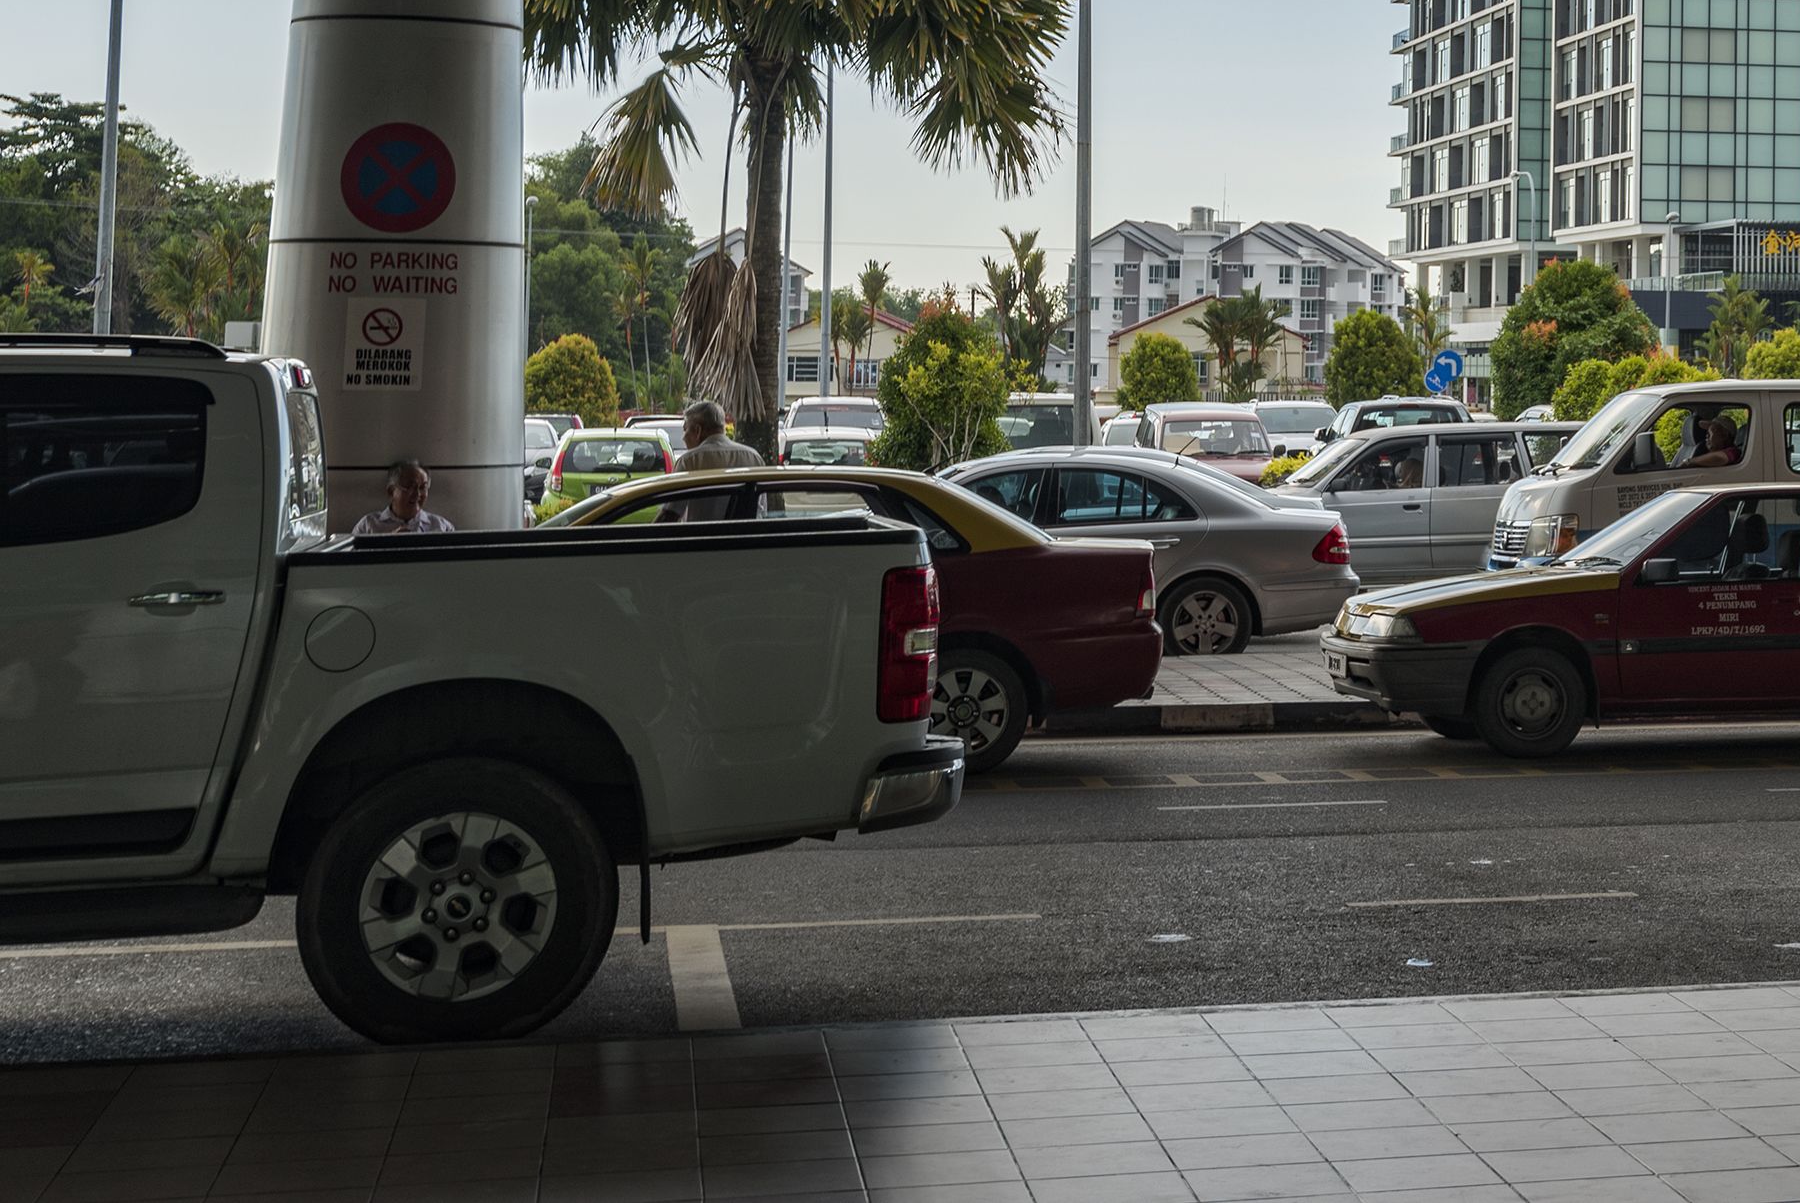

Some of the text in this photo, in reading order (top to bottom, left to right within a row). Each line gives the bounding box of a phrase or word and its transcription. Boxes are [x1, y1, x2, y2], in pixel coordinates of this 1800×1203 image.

[330, 252, 458, 270] NO PARKING
[328, 275, 458, 294] NO WAITING
[355, 349, 412, 360] DILARANG
[355, 360, 411, 371] MEROKOK
[346, 374, 418, 386] NO SMOKIN
[1713, 592, 1737, 600] TEKSI
[1706, 600, 1757, 610] PENUMPANG
[1719, 613, 1739, 622] MIRI
